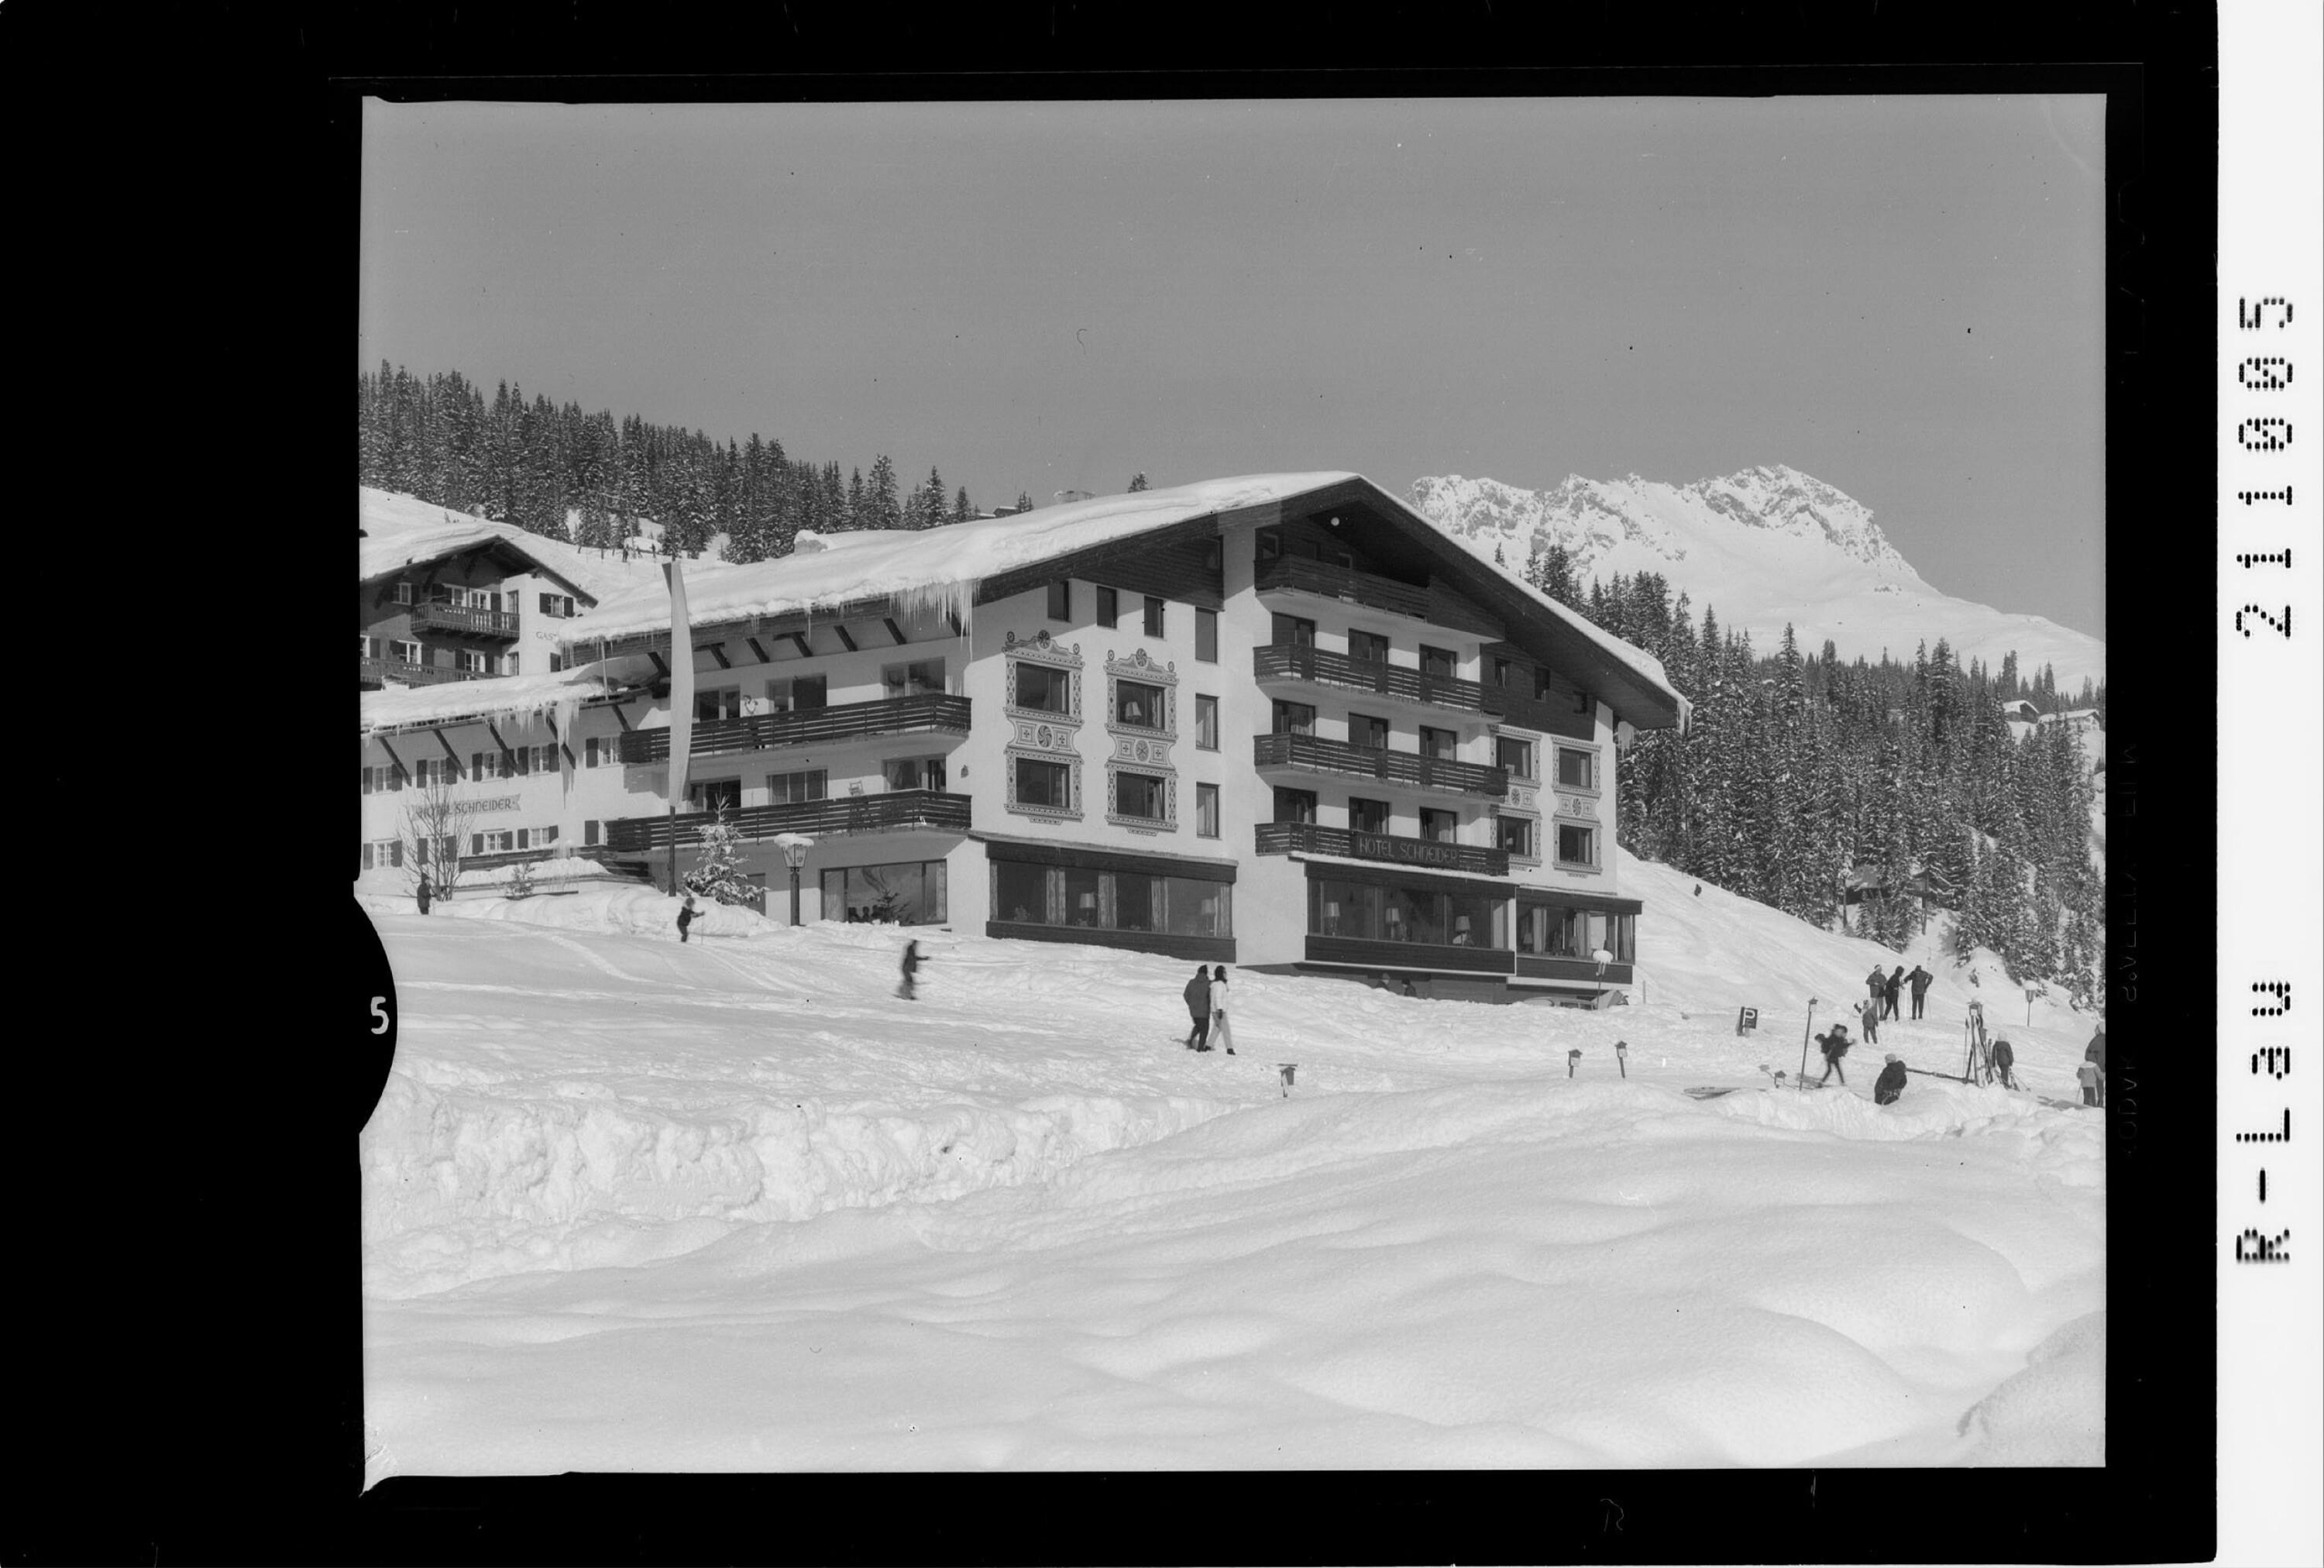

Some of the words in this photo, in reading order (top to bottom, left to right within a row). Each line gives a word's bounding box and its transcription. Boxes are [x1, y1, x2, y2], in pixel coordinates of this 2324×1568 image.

[535, 631, 558, 641] GAS
[456, 799, 511, 813] SCHNEIDER
[1360, 837, 1394, 858] HOTEL
[1400, 842, 1457, 863] SCHNEIDER
[370, 995, 390, 1035] 5
[1742, 1009, 1755, 1026] P
